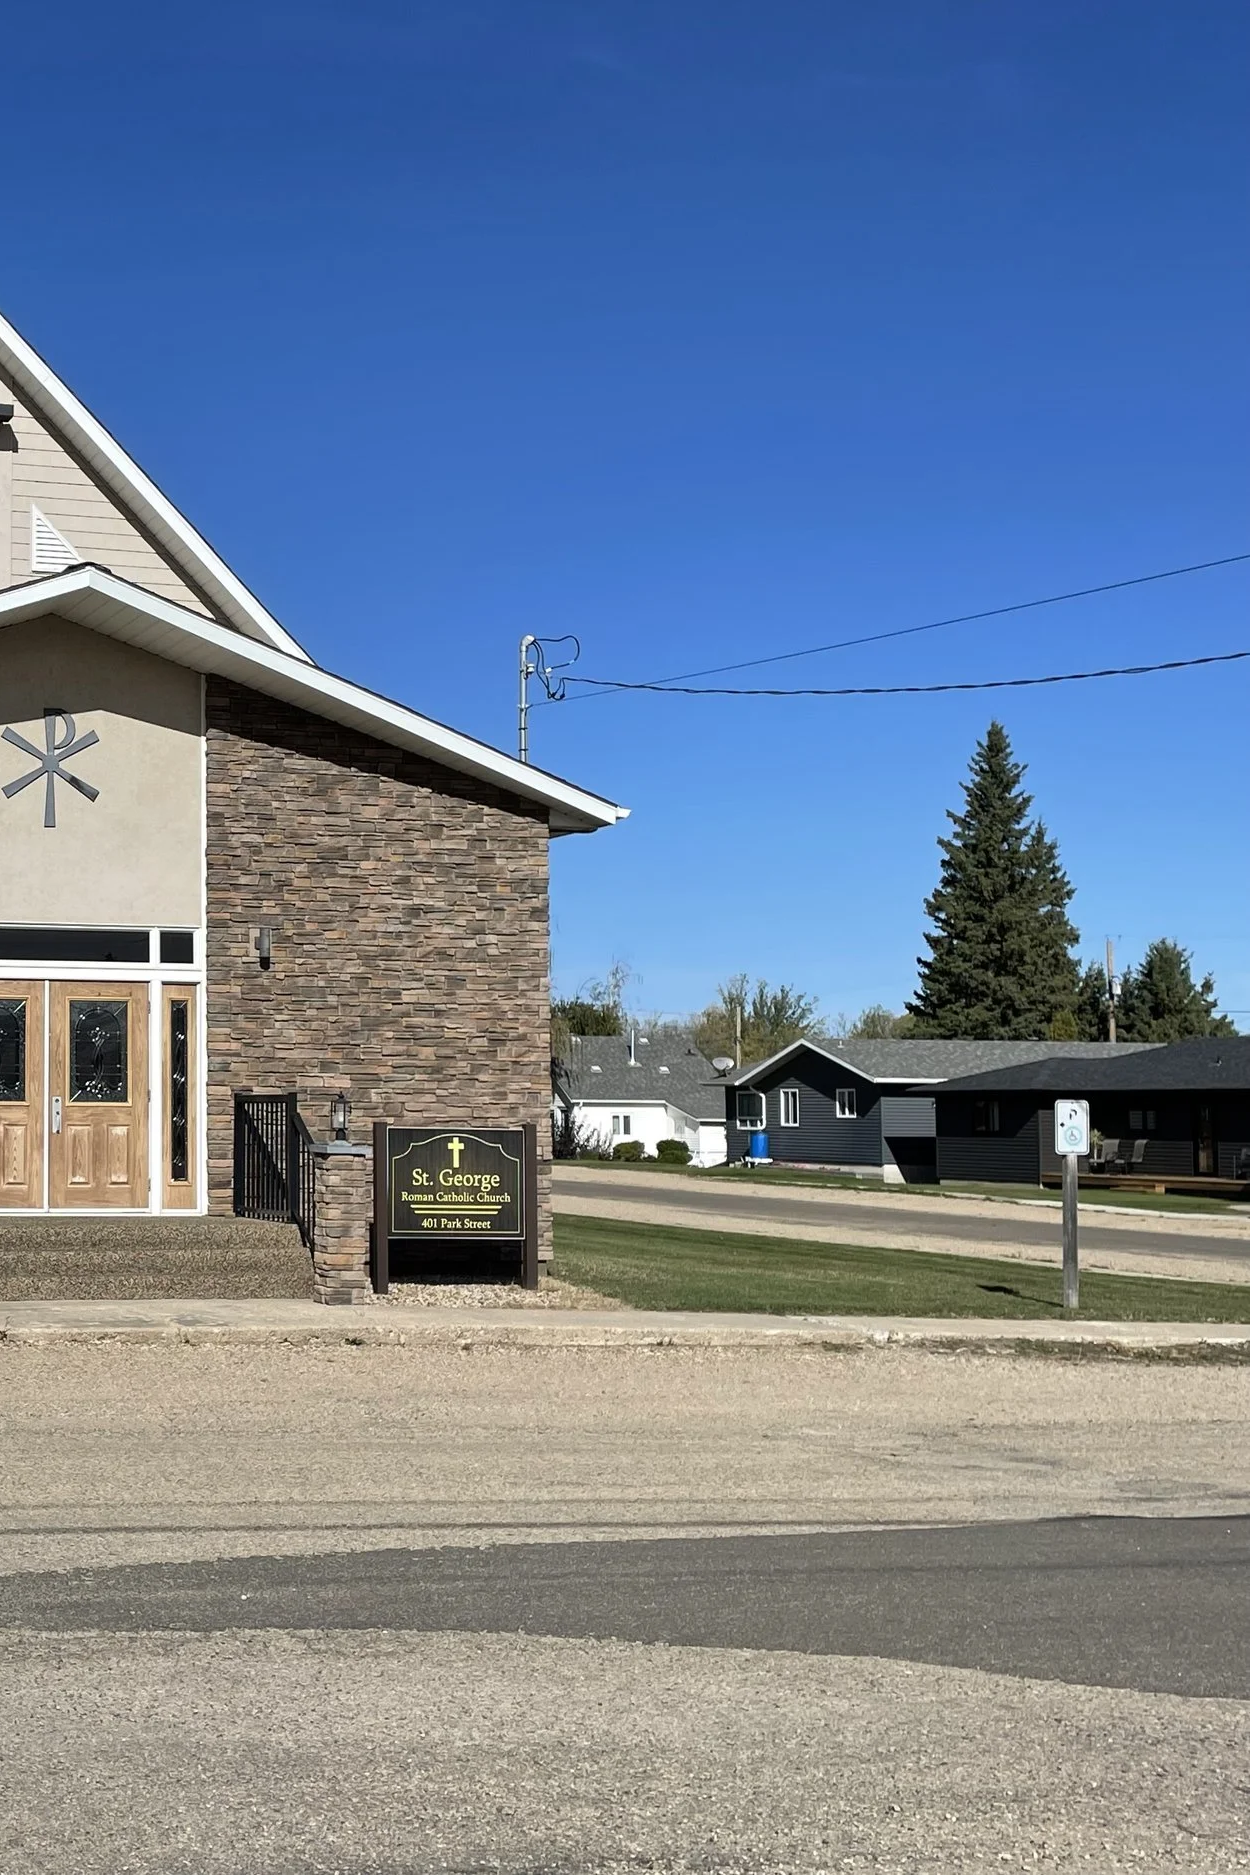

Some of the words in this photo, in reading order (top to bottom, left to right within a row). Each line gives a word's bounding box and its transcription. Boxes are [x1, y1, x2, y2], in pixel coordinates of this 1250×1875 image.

[412, 1168, 434, 1186] St.
[439, 1168, 500, 1191] George
[401, 1192, 434, 1202] Roman
[436, 1192, 475, 1202] Catholic
[476, 1192, 511, 1203] Church
[421, 1218, 438, 1228] 401
[440, 1218, 462, 1229] Park
[463, 1218, 491, 1229] Street
